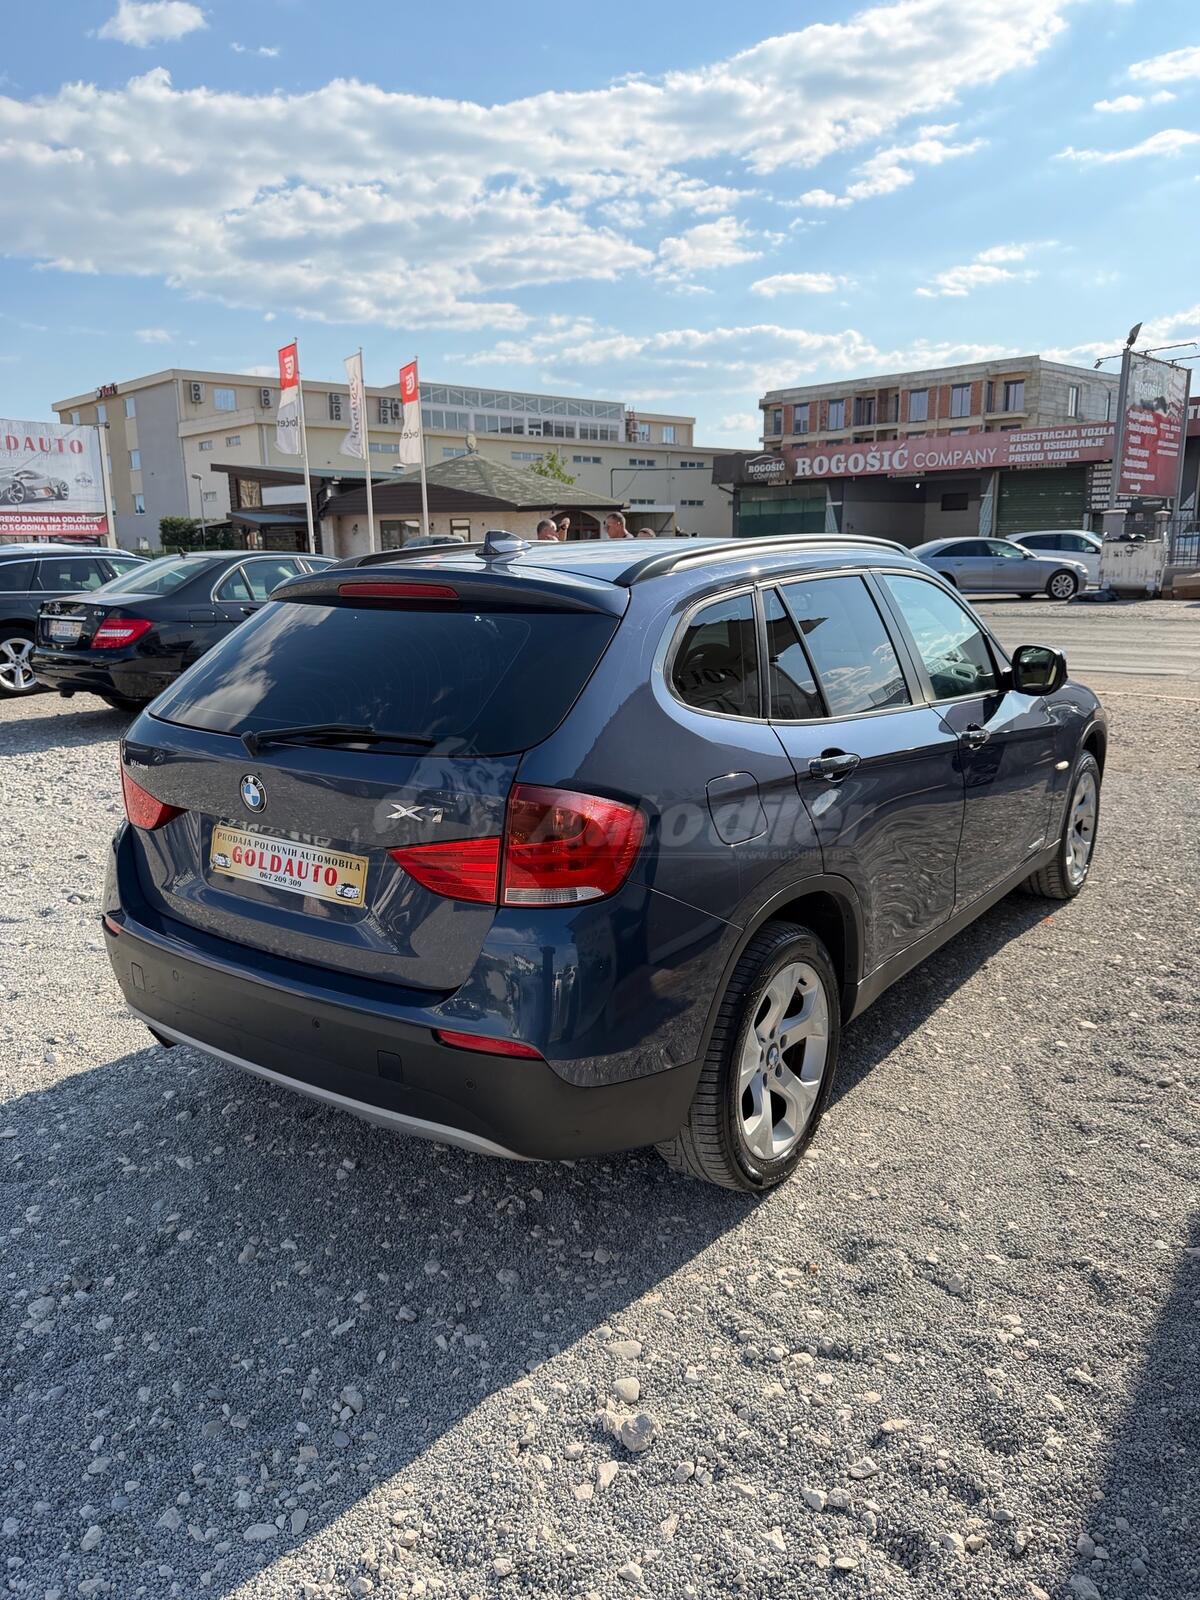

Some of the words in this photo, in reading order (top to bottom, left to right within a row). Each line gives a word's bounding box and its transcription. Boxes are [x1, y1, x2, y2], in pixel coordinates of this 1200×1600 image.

[1009, 429, 1078, 442] REGISTRACIJA
[1081, 426, 1115, 437] VOZILA
[0, 434, 83, 455] DAUTO
[1008, 442, 1041, 453] KASKO
[1043, 437, 1105, 450] OSIGURANJE
[794, 443, 909, 477] ROGOŠIĆ
[912, 447, 998, 468] COMPANY
[1047, 450, 1080, 460] VOZILA
[747, 460, 785, 474] ROGOŠIĆ
[22, 515, 49, 523] BANKE
[50, 515, 61, 523] NA
[63, 523, 99, 531] ŽIRANATA
[386, 803, 444, 824] X1
[217, 832, 252, 847] PRODAJA
[254, 840, 298, 858] POLOVNIH
[300, 850, 361, 872] AUTOMOBILA
[232, 846, 338, 887] GOLDAUTO
[259, 871, 272, 881] 067
[274, 875, 287, 885] 209
[288, 878, 302, 888] 309
